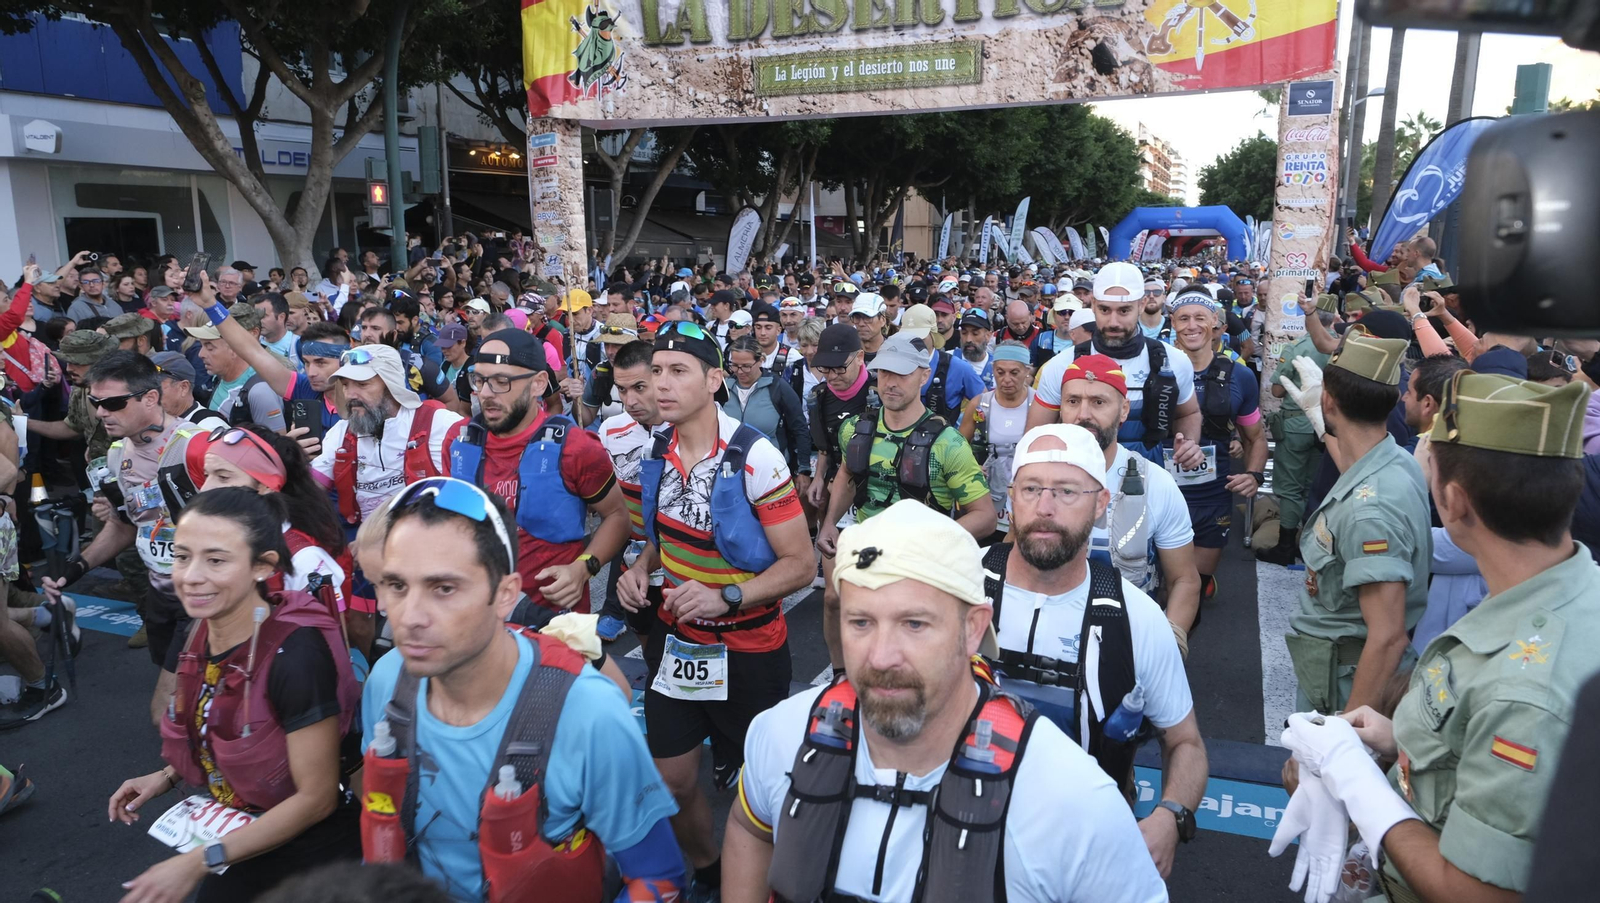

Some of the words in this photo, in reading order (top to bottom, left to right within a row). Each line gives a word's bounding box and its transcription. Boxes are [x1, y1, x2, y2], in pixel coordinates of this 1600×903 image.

[775, 66, 787, 82] La
[791, 63, 826, 82] Legión
[832, 66, 839, 81] y
[844, 61, 855, 76] el
[859, 59, 903, 76] desierto
[909, 60, 929, 73] nos
[935, 57, 956, 71] une
[1286, 153, 1326, 161] GRUPO
[1285, 161, 1326, 171] RENTA
[1284, 172, 1326, 186] TODO
[1276, 269, 1318, 278] primaflor
[1158, 385, 1173, 431] KIPRUN
[672, 658, 709, 681] 205
